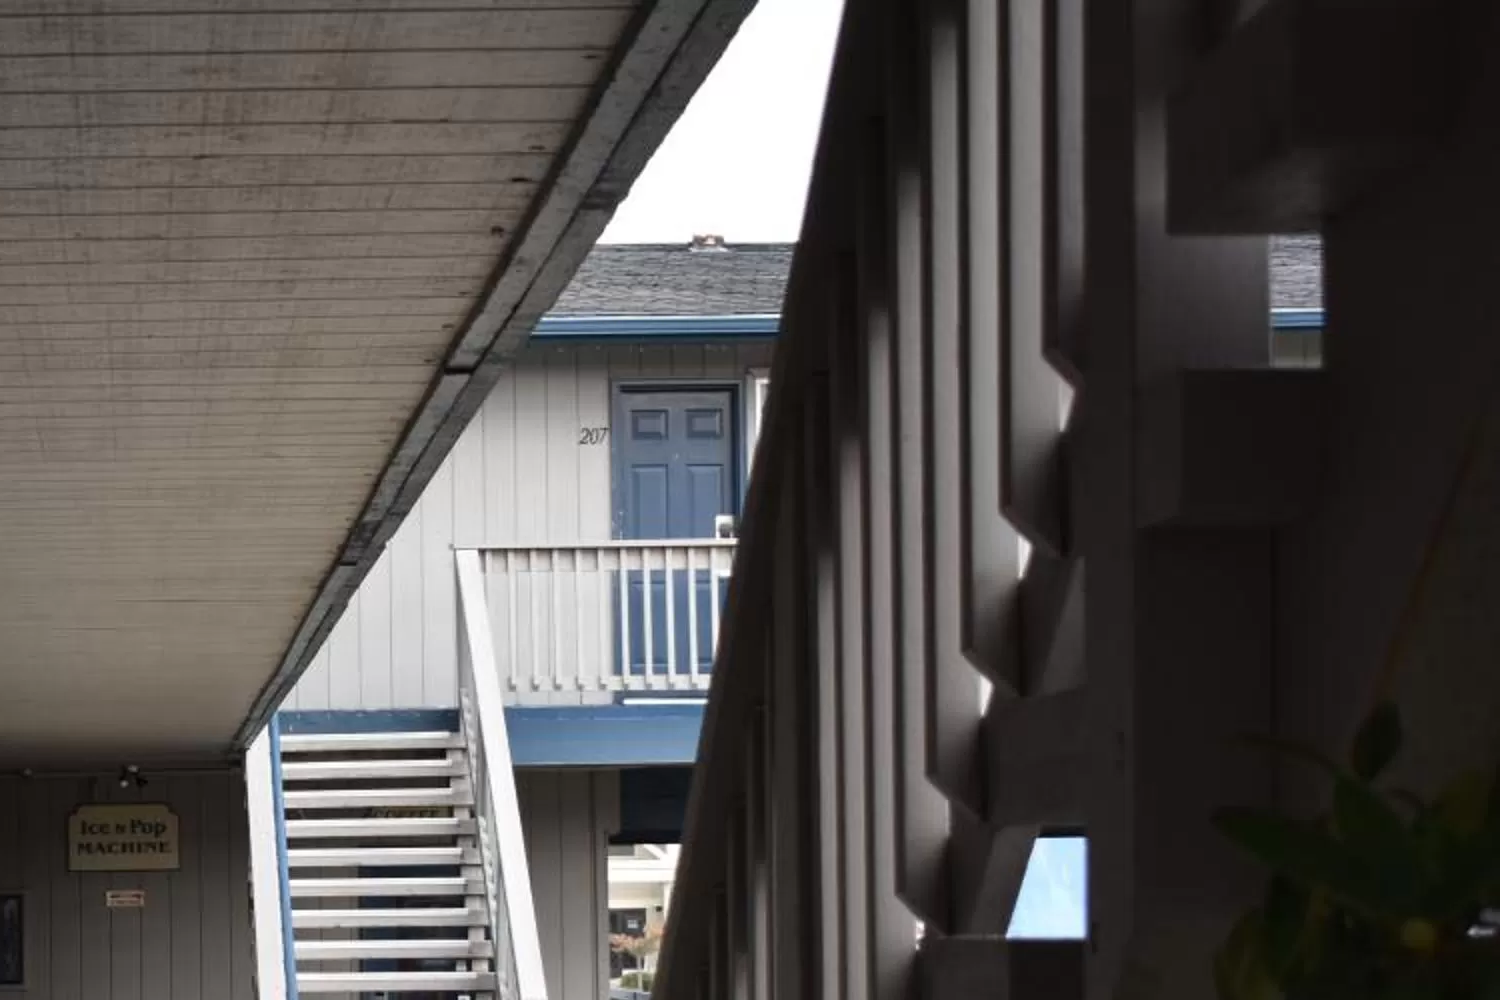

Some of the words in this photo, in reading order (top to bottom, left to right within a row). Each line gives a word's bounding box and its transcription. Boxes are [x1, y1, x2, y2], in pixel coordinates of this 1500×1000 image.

[578, 426, 610, 445] 207
[79, 819, 111, 836] Ice
[130, 819, 168, 839] Pop
[76, 840, 173, 856] MACHINE
